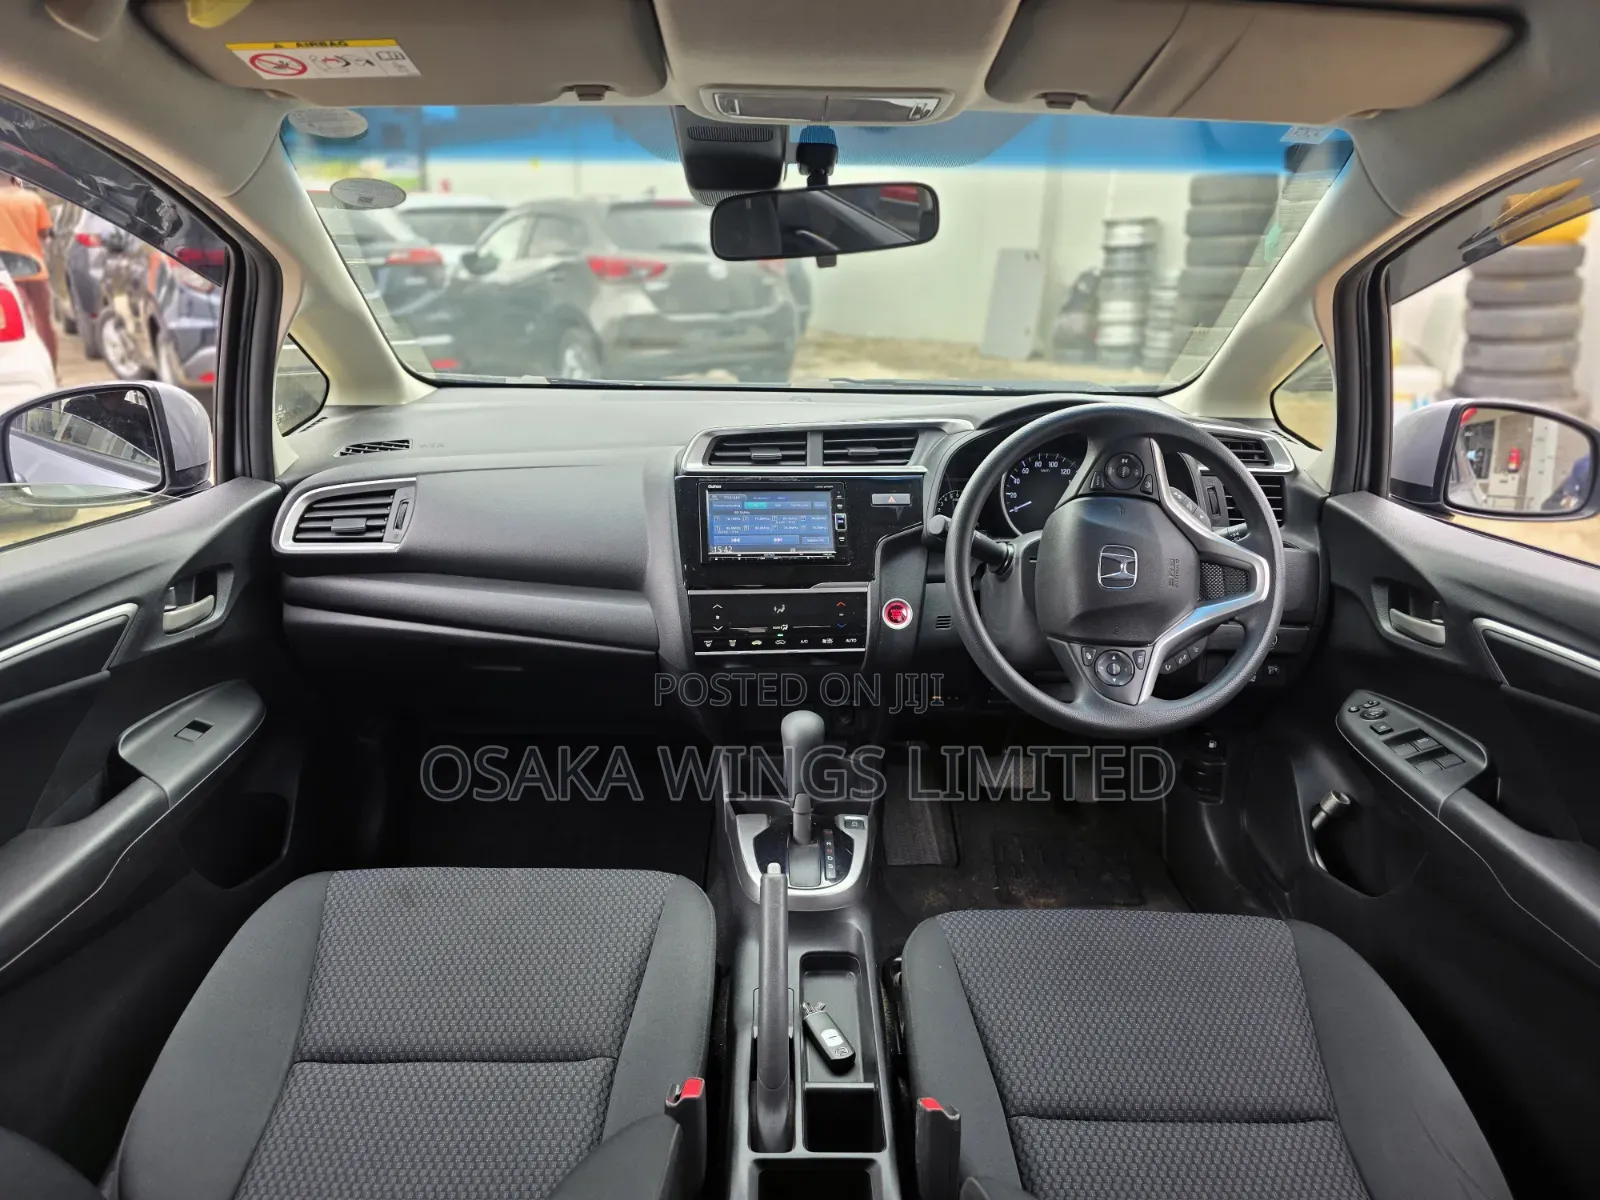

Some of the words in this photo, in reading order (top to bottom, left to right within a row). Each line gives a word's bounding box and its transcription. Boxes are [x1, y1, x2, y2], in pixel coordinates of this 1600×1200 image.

[295, 40, 349, 48] AIRBAG
[1021, 467, 1030, 475] 60
[1013, 477, 1021, 485] 40
[713, 545, 733, 553] 15:42
